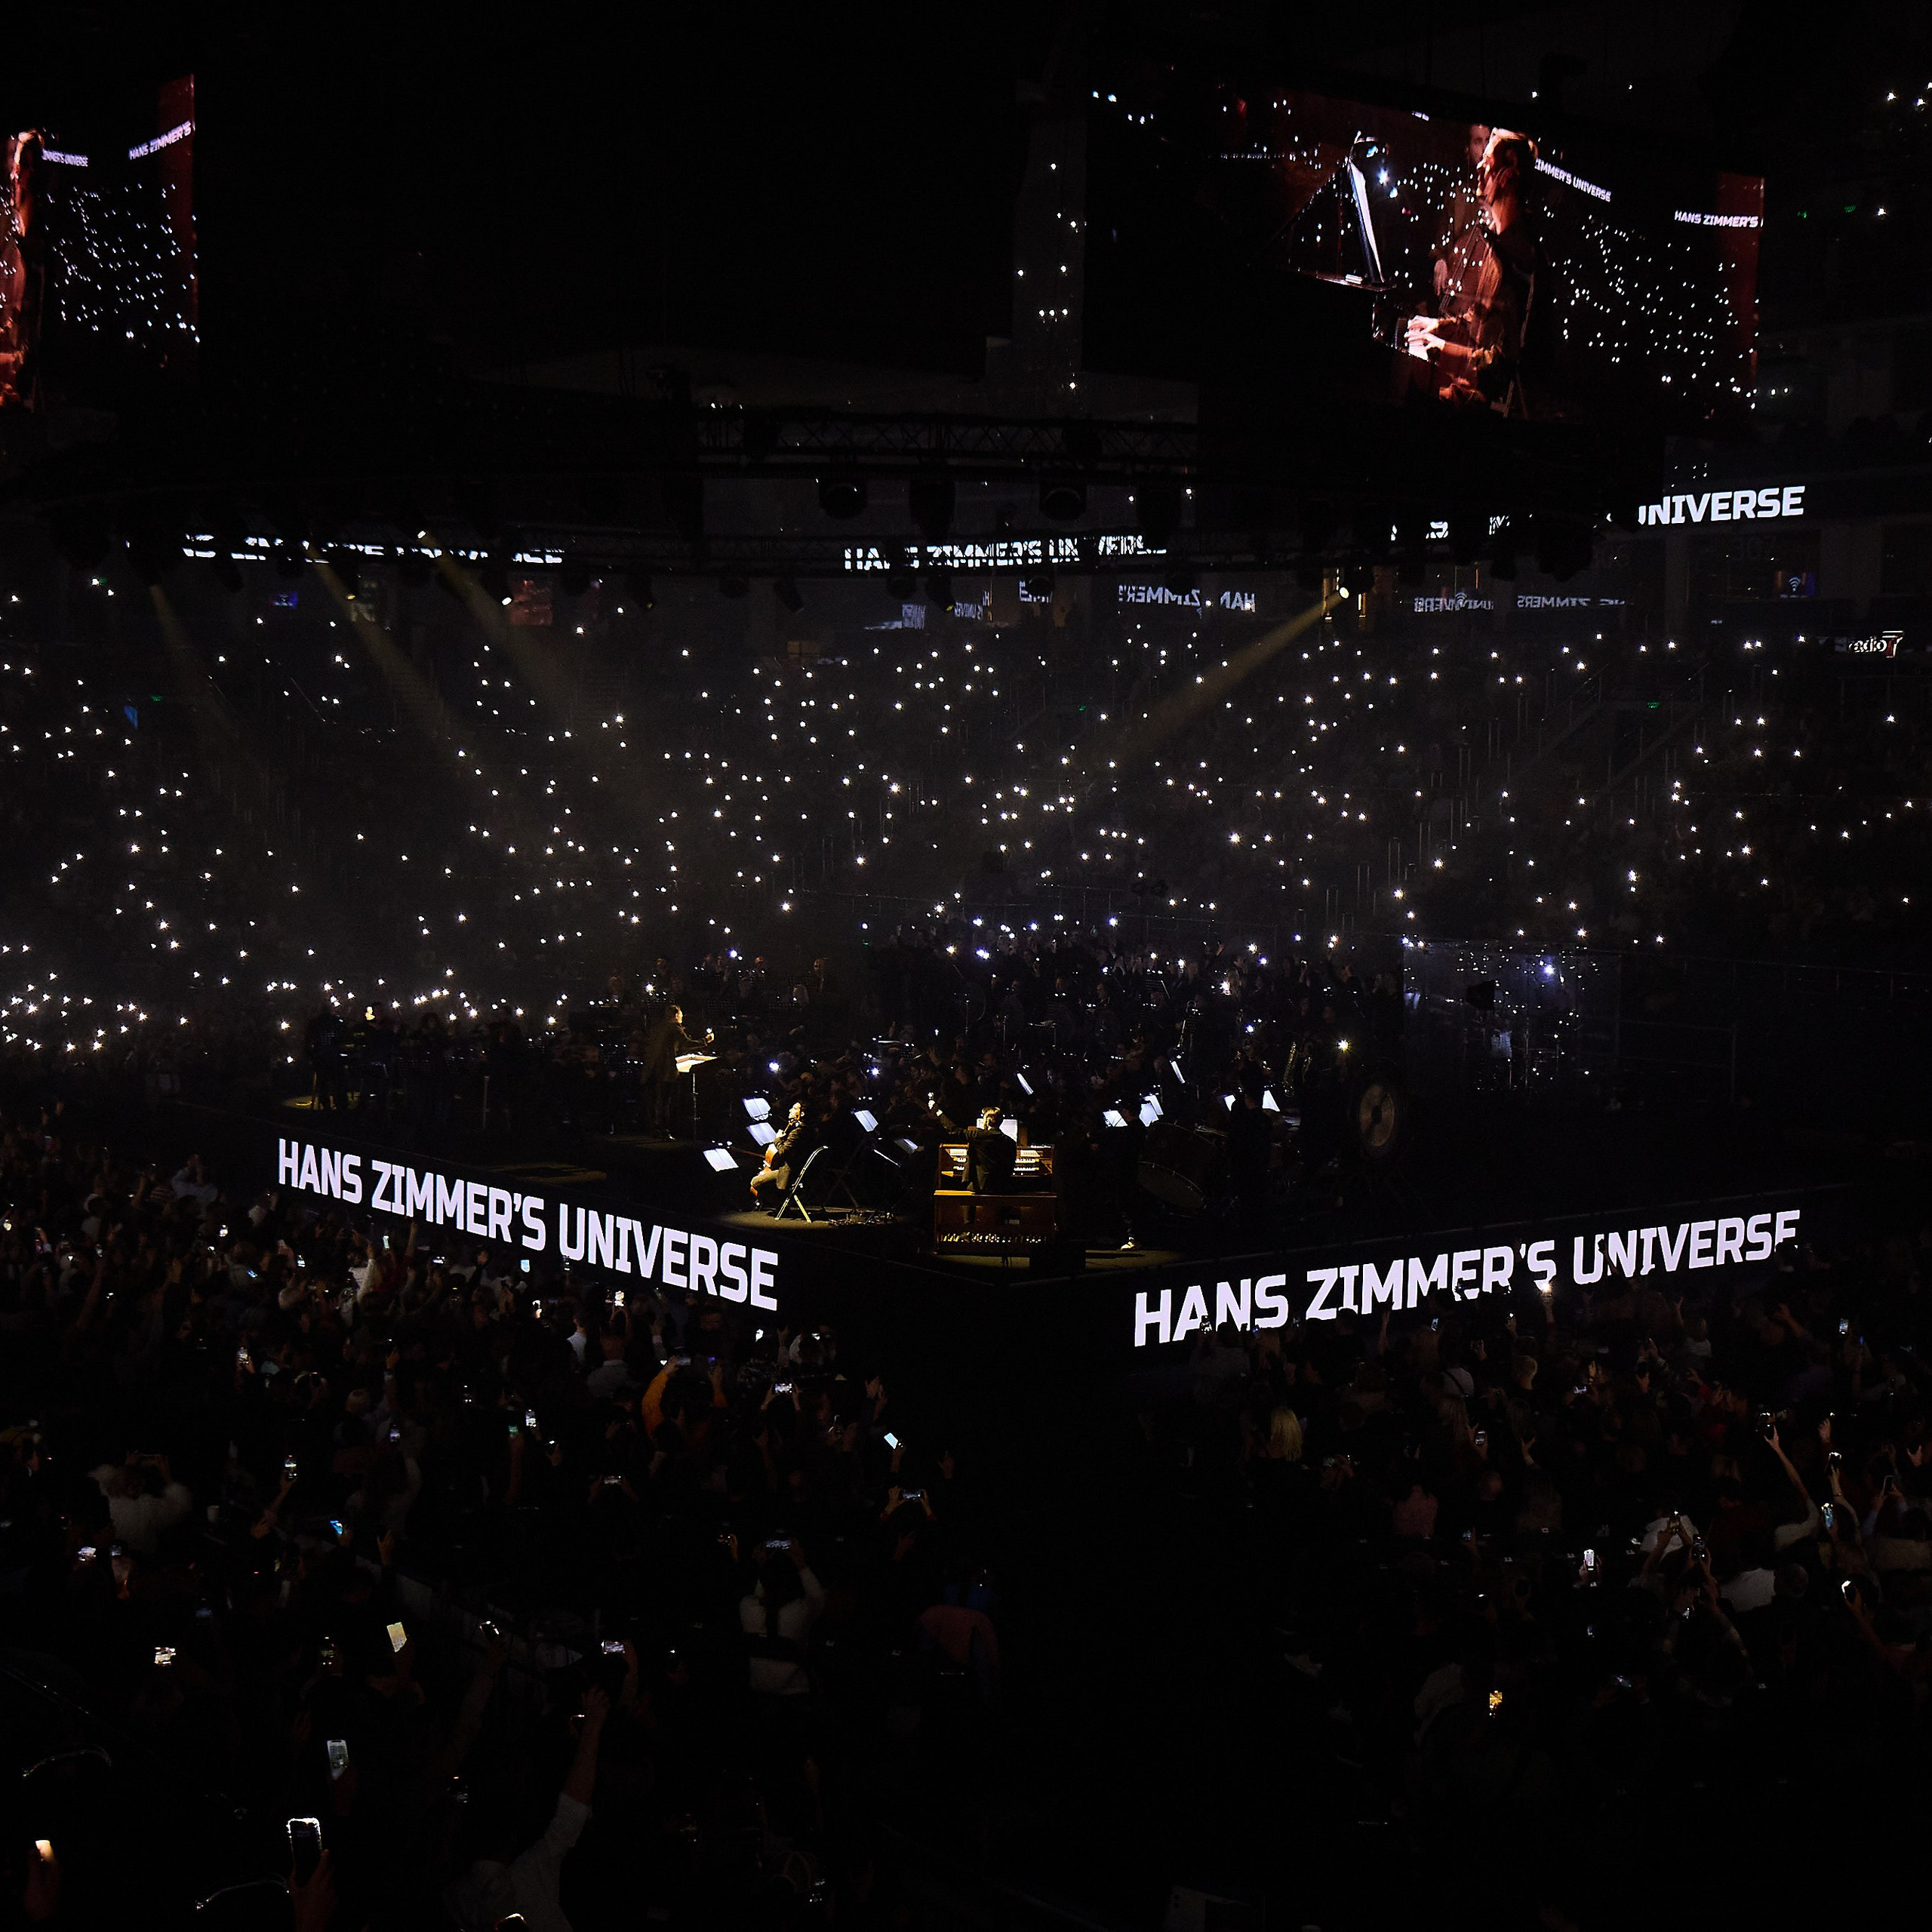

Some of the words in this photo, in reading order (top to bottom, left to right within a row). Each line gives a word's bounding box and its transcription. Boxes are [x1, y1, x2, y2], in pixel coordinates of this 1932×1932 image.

[1572, 174, 1612, 203] UNIVERSE
[1674, 210, 1702, 224] HANS
[1703, 214, 1758, 228] ZIMMER'S
[278, 1138, 362, 1204] HANS
[371, 1159, 546, 1251] ZIMMER'S
[559, 1203, 778, 1311] UNIVERSE
[1134, 1274, 1288, 1346] HANS
[1306, 1240, 1557, 1321] ZIMMER'S
